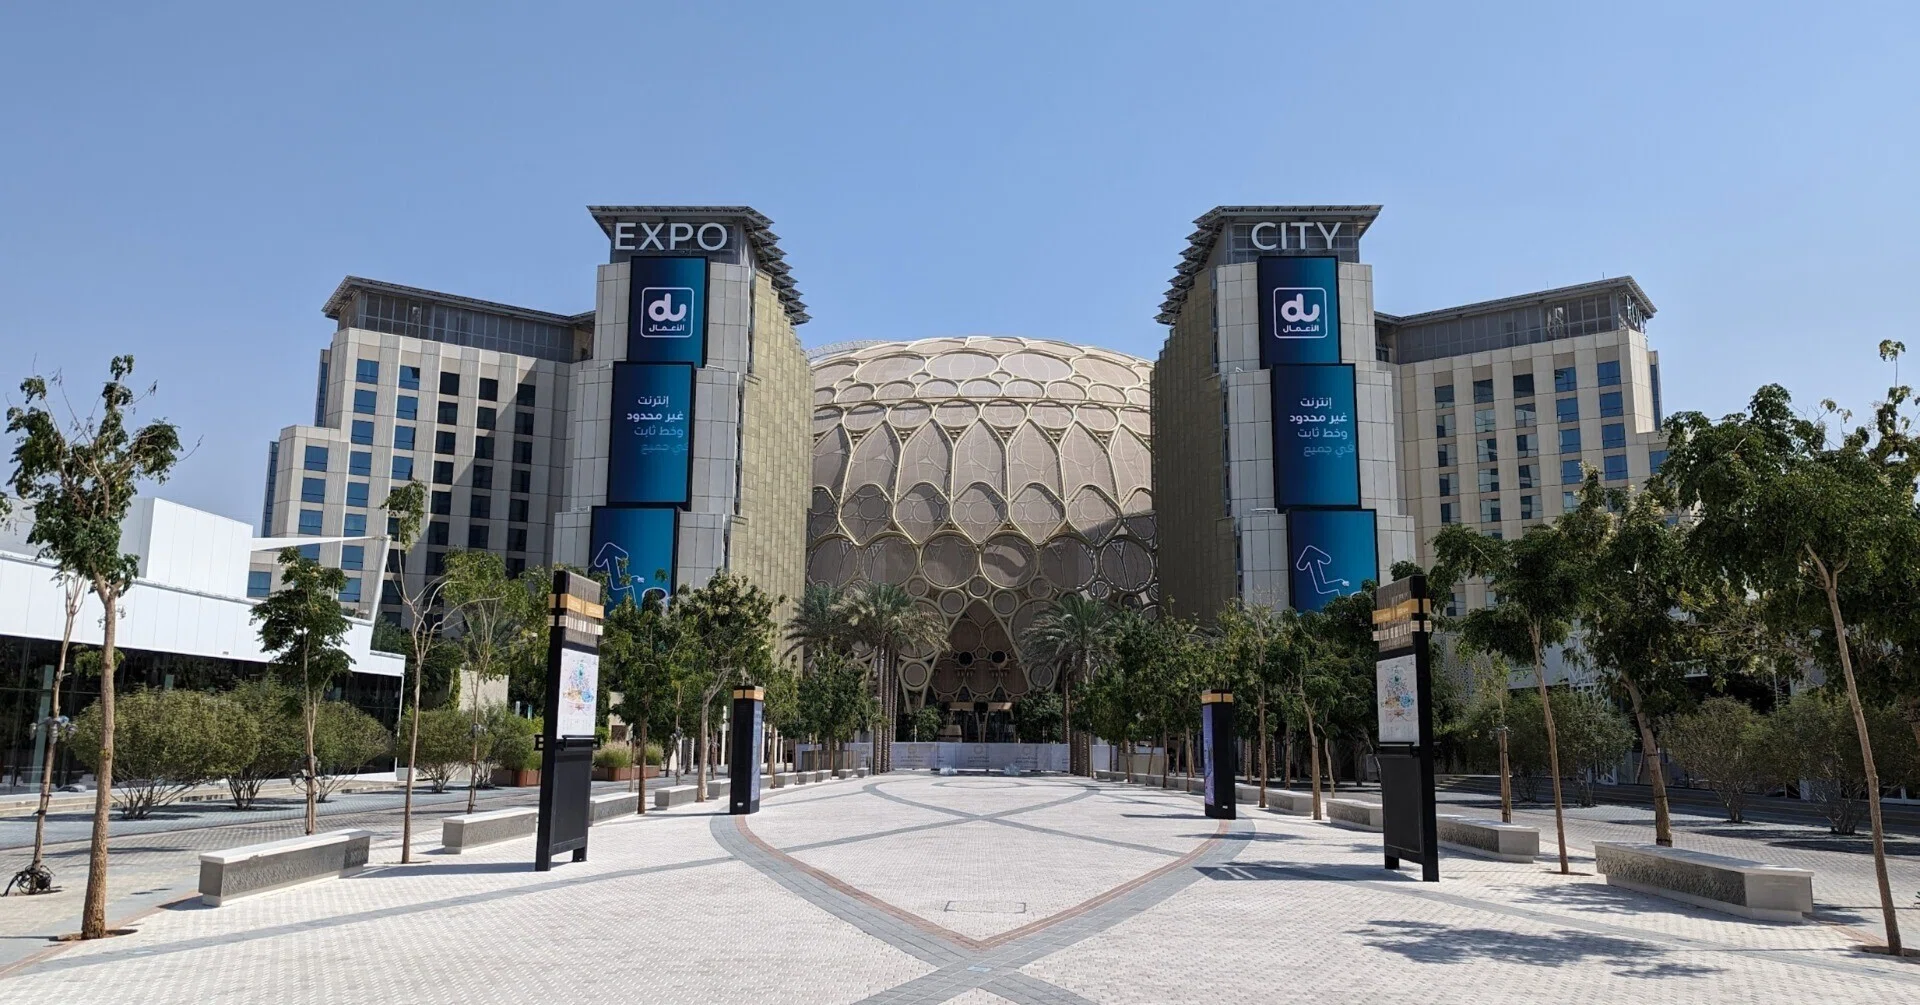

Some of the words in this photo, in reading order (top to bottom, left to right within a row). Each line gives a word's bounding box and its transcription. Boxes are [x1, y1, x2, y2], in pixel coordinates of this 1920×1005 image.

[615, 222, 728, 251] EXPO
[1251, 221, 1342, 251] CITY
[648, 293, 687, 322] du
[1280, 293, 1320, 322] du
[648, 324, 685, 333] الأعمال
[1283, 324, 1320, 333] الأعمال
[638, 395, 669, 408] إنترنت
[1300, 397, 1332, 410] إنترنت
[626, 412, 663, 422] محدود
[664, 410, 684, 423] غير
[1289, 414, 1326, 424] محدود
[1328, 412, 1348, 424] غير
[634, 425, 656, 438] ثابت
[658, 427, 684, 438] وخط
[1297, 427, 1320, 440] ثابت
[1322, 428, 1348, 440] وخط
[1303, 444, 1332, 457] جميع
